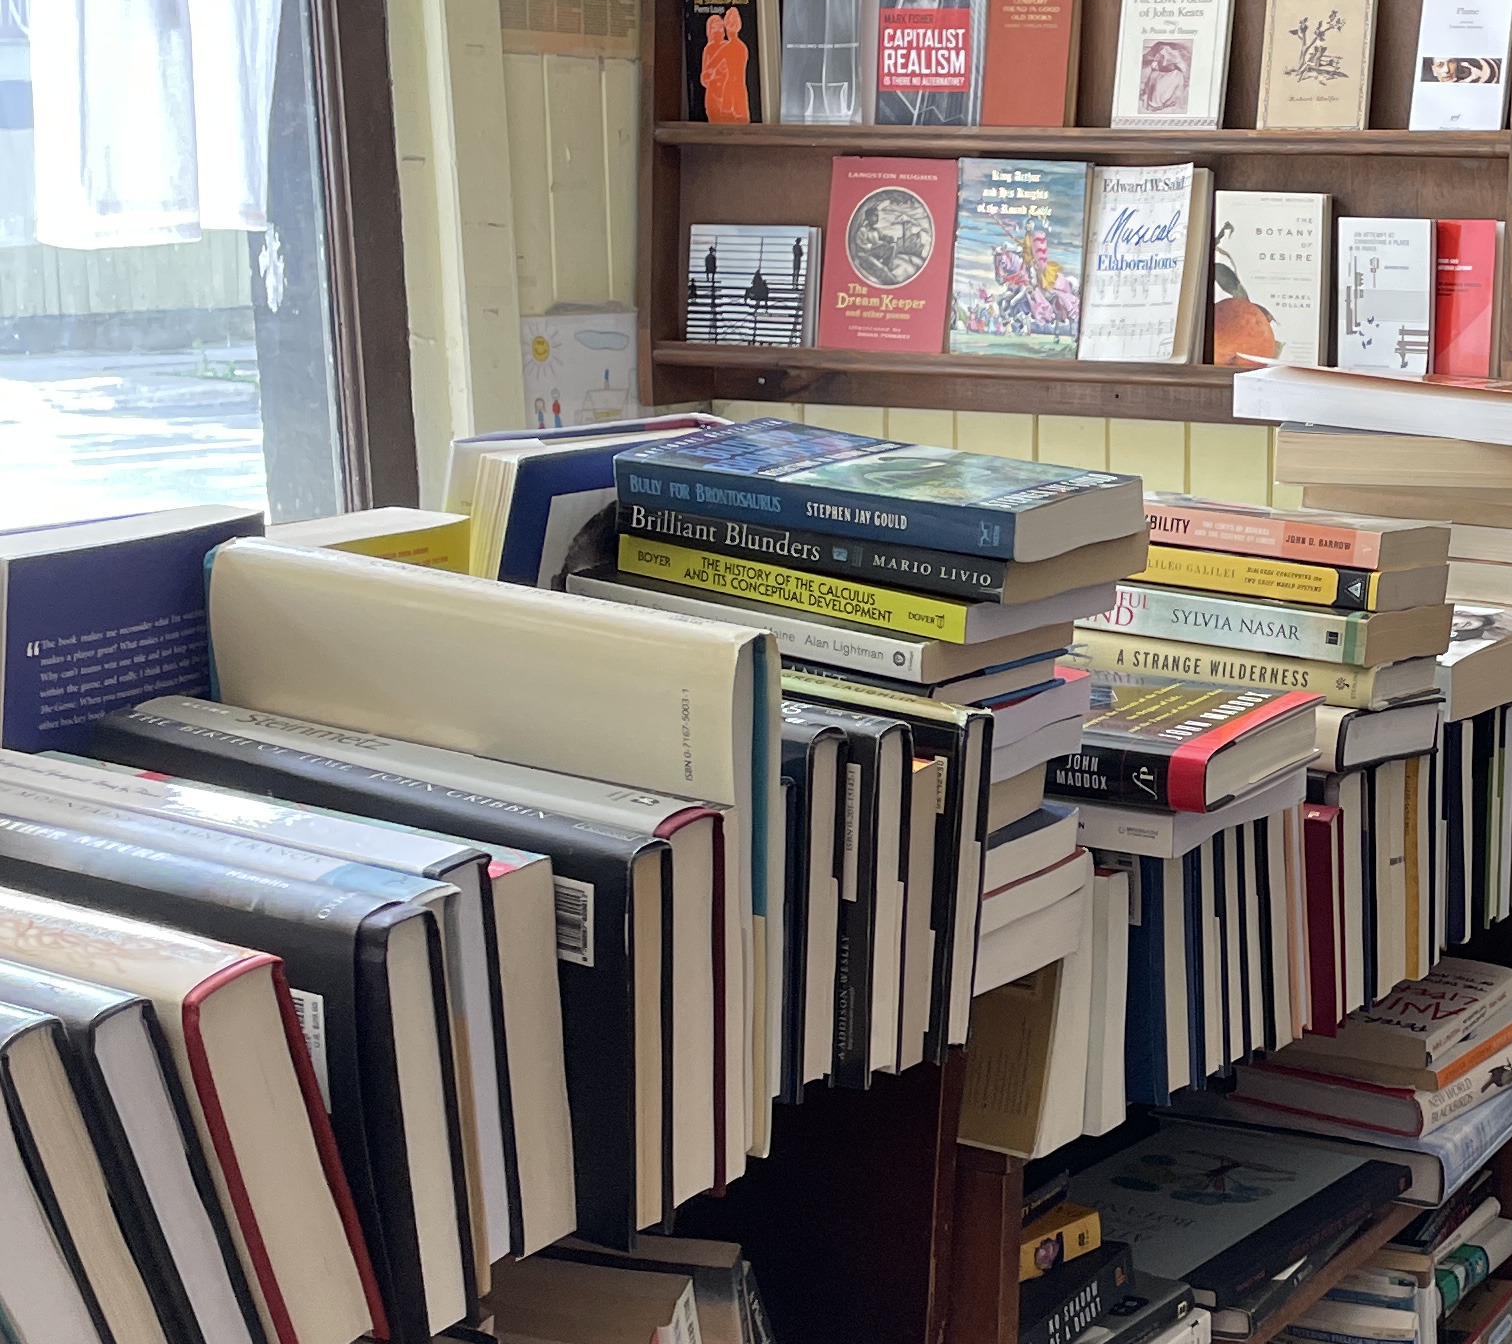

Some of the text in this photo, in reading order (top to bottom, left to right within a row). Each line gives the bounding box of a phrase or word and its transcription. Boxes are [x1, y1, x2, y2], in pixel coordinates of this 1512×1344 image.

[1139, 6, 1204, 19] of John Keats
[883, 29, 966, 48] CAPITALIST
[883, 49, 966, 74] REALISM
[1102, 178, 1149, 194] Edward
[1162, 175, 1186, 191] Said
[1103, 207, 1181, 254] Musical
[1255, 228, 1314, 238] BOTANY
[1097, 254, 1178, 272] Elaborations
[1259, 252, 1314, 262] DESIRE
[836, 293, 926, 310] Dream Keeper
[848, 284, 868, 295] The
[806, 502, 908, 530] STEPHEN JAY GOULD
[630, 505, 821, 561] Brilliant Blunders
[701, 556, 721, 572] THE
[774, 571, 789, 586] OF
[793, 577, 814, 593] THE
[817, 583, 876, 605] CALCULUS
[873, 554, 992, 587] MARIO LIVIO
[683, 567, 893, 624] AND ITS CONCEPTUAL DEVELOPMENT
[1171, 608, 1300, 641] SYLVIA NASAR
[1116, 649, 1310, 688] A STRANGE WILDERNESS
[1066, 753, 1098, 772] JOHN
[1056, 765, 1108, 790] MADDOX
